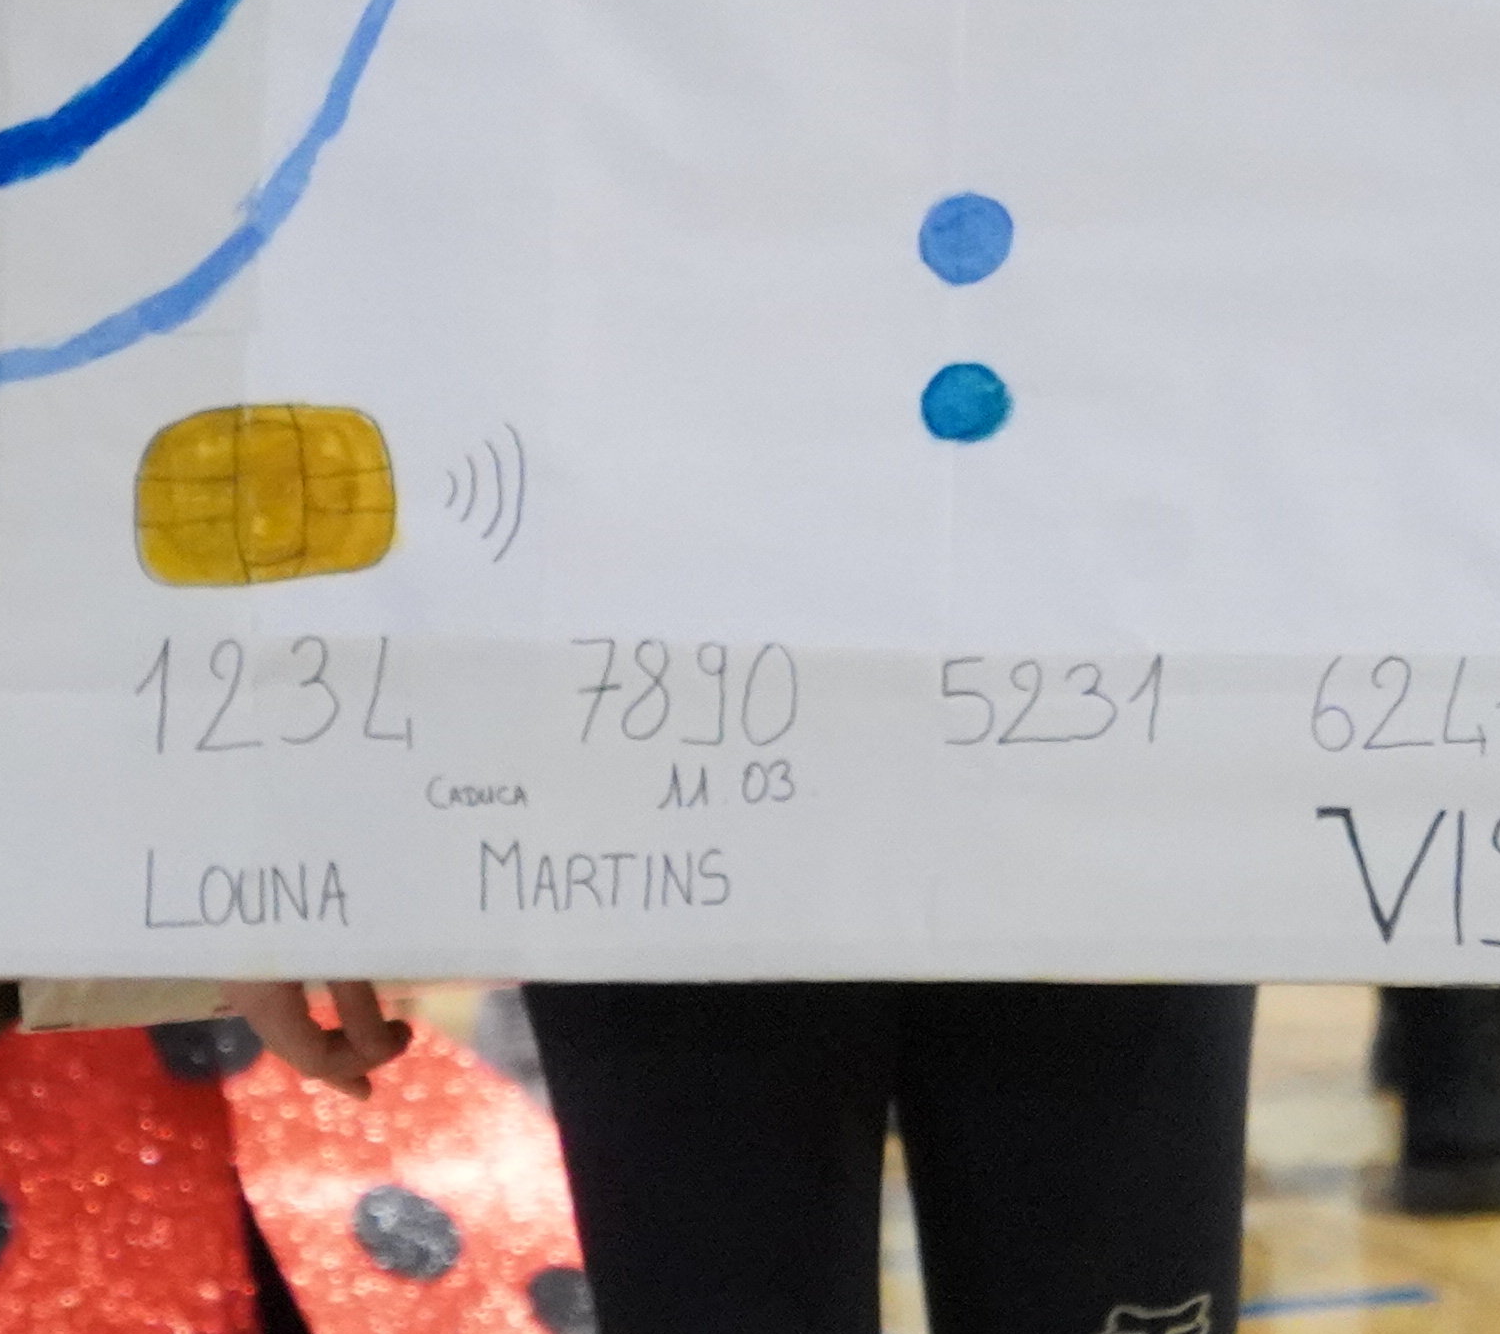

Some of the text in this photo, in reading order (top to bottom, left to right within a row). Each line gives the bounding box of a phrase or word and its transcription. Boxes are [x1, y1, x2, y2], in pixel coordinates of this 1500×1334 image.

[134, 634, 414, 755] 1234
[570, 638, 799, 748] 7890
[941, 652, 1164, 746] 5231
[144, 839, 731, 929] LOUNA MARTINS
